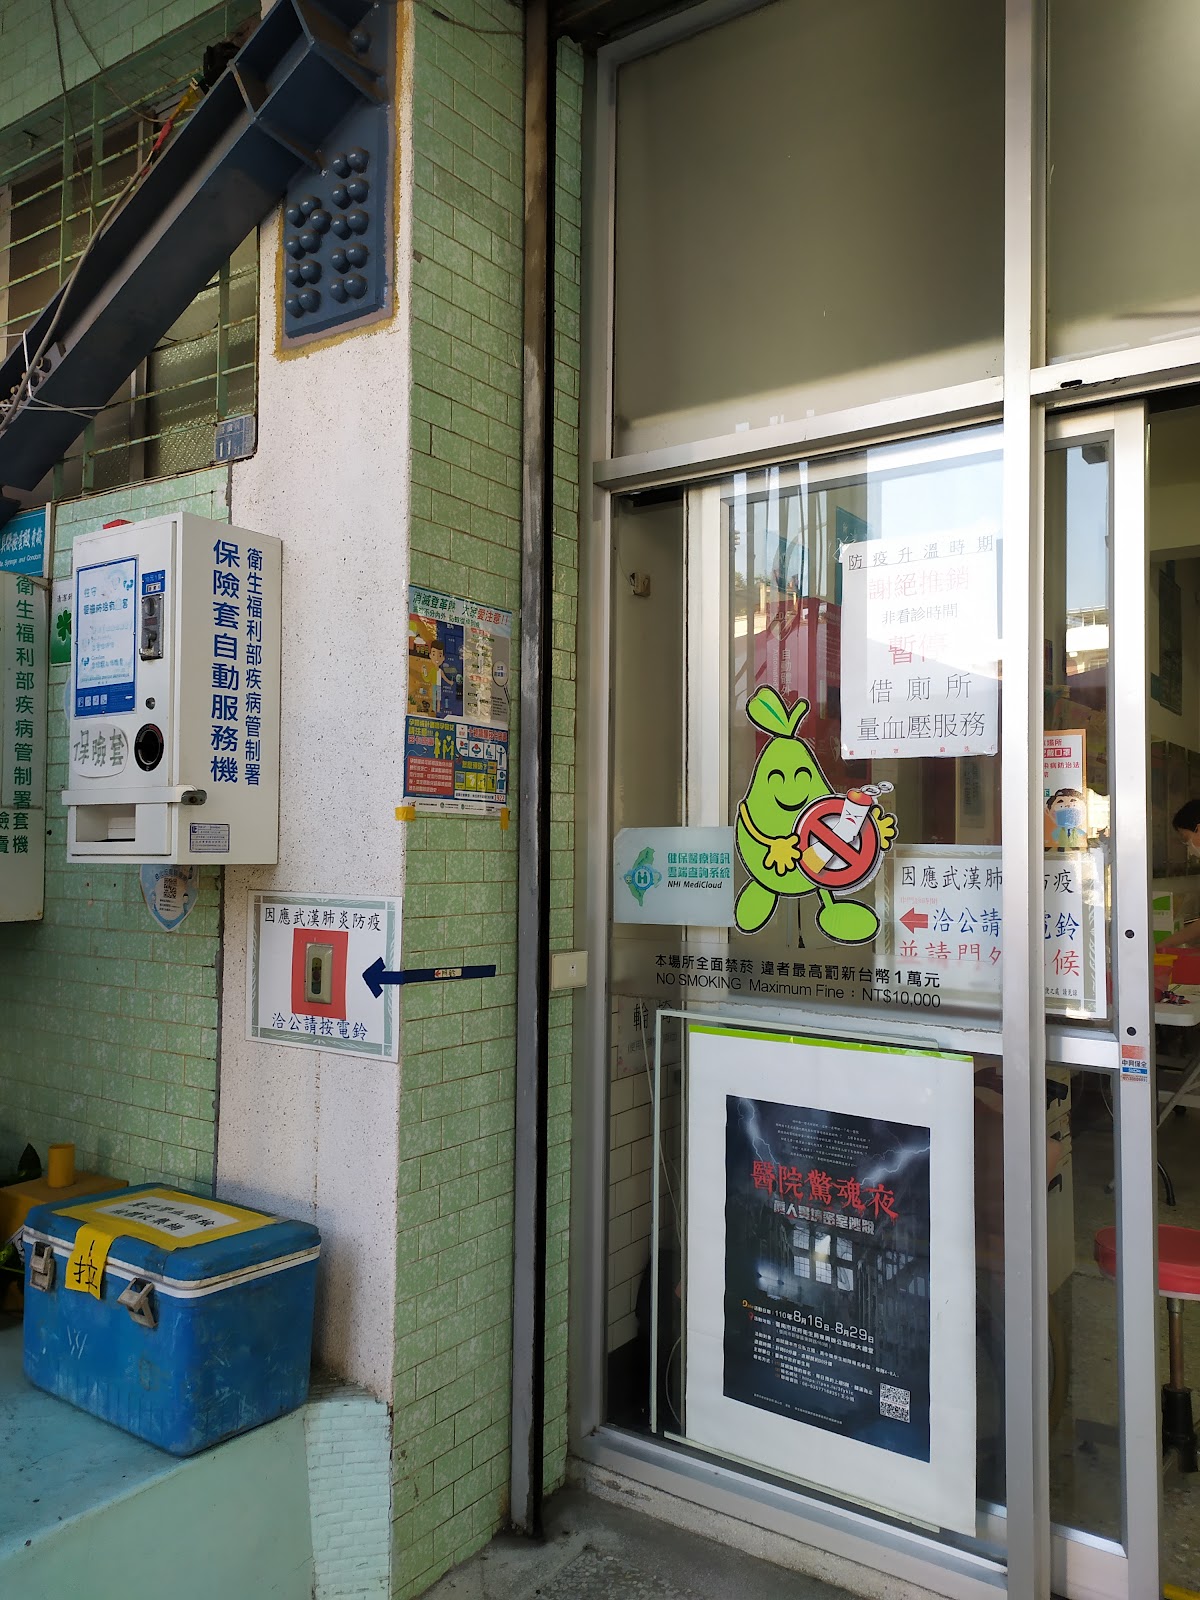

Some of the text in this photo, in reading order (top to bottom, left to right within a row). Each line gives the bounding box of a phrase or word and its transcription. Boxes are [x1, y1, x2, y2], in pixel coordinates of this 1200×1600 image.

[848, 534, 993, 570] 防疫升溫時期
[882, 603, 958, 625] 非看診時間
[210, 538, 240, 784] 保險套自動服務機
[244, 547, 263, 786] 衛生福利部疾病管制署
[13, 575, 35, 809] 衛生福利部疾病管制署
[869, 673, 972, 704] 借廁所
[856, 711, 986, 741] 量血壓服務
[74, 728, 124, 767] 保險套
[1044, 739, 1062, 747] 場所
[667, 852, 730, 865] 健保醫療資訊
[667, 866, 730, 880] 雲端查詢系統
[667, 880, 722, 889] NHI MediCloud
[264, 907, 382, 932] 因應武漢肺炎防疫
[655, 954, 754, 974] 本場所全面禁菸
[656, 972, 676, 985] NO
[678, 973, 742, 991] SMOKING
[750, 980, 812, 996] Maximum
[816, 986, 845, 998] Fine
[862, 988, 941, 1008] NT$10,000
[272, 1012, 368, 1041] 洽公請按電鈴
[751, 1160, 899, 1226] 醫院驚魂夜
